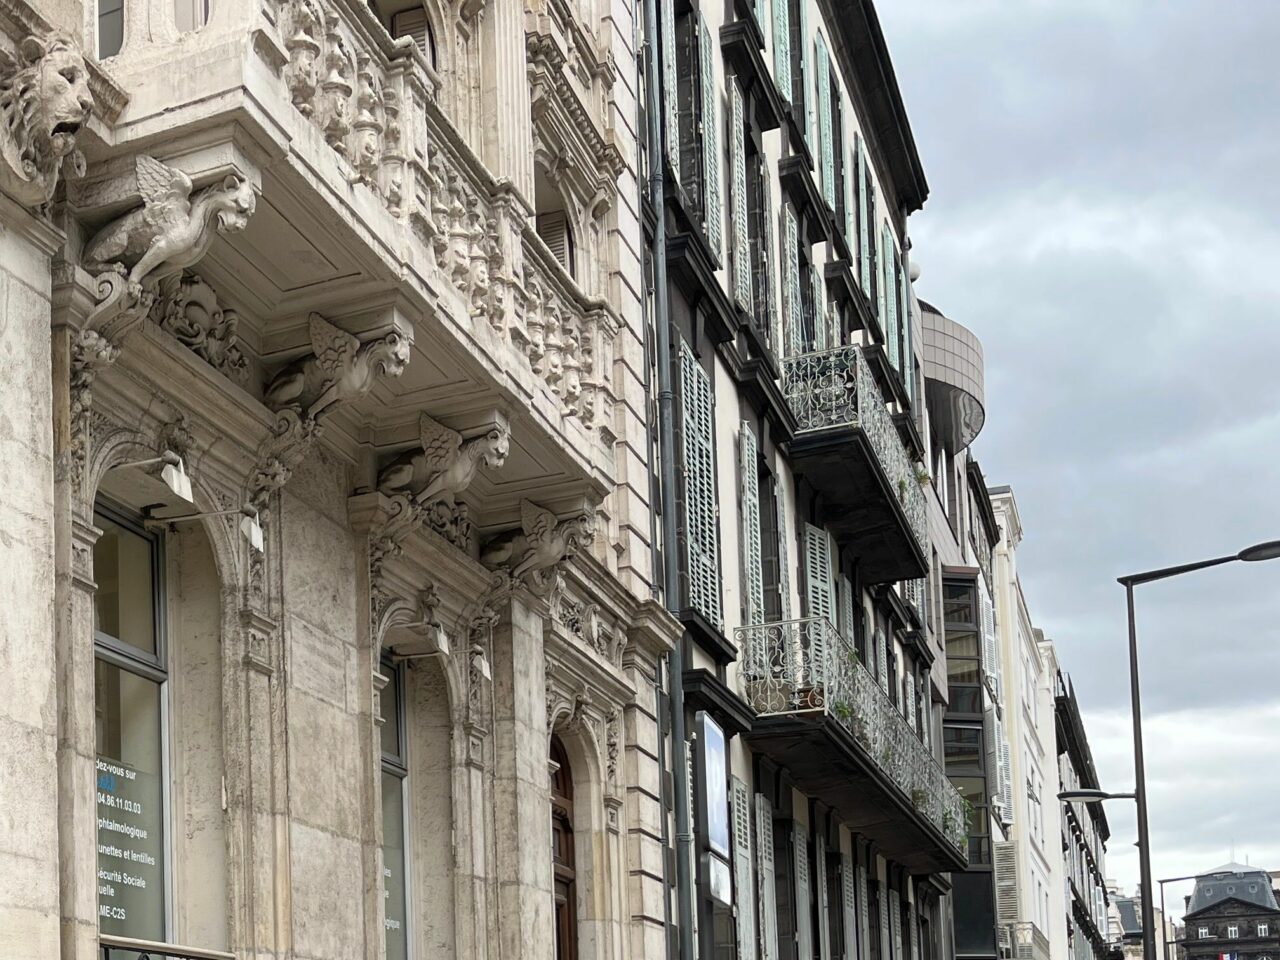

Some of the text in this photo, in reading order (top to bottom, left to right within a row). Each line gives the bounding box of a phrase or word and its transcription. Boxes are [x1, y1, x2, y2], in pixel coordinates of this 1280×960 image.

[125, 770, 137, 780] sur
[97, 792, 141, 814] 04.86.11.03.03
[96, 817, 148, 839] phtalmologique
[123, 849, 130, 860] et
[131, 850, 155, 865] lentilles
[97, 867, 146, 889] écurité Sociale
[99, 905, 126, 920] ME-C2S
